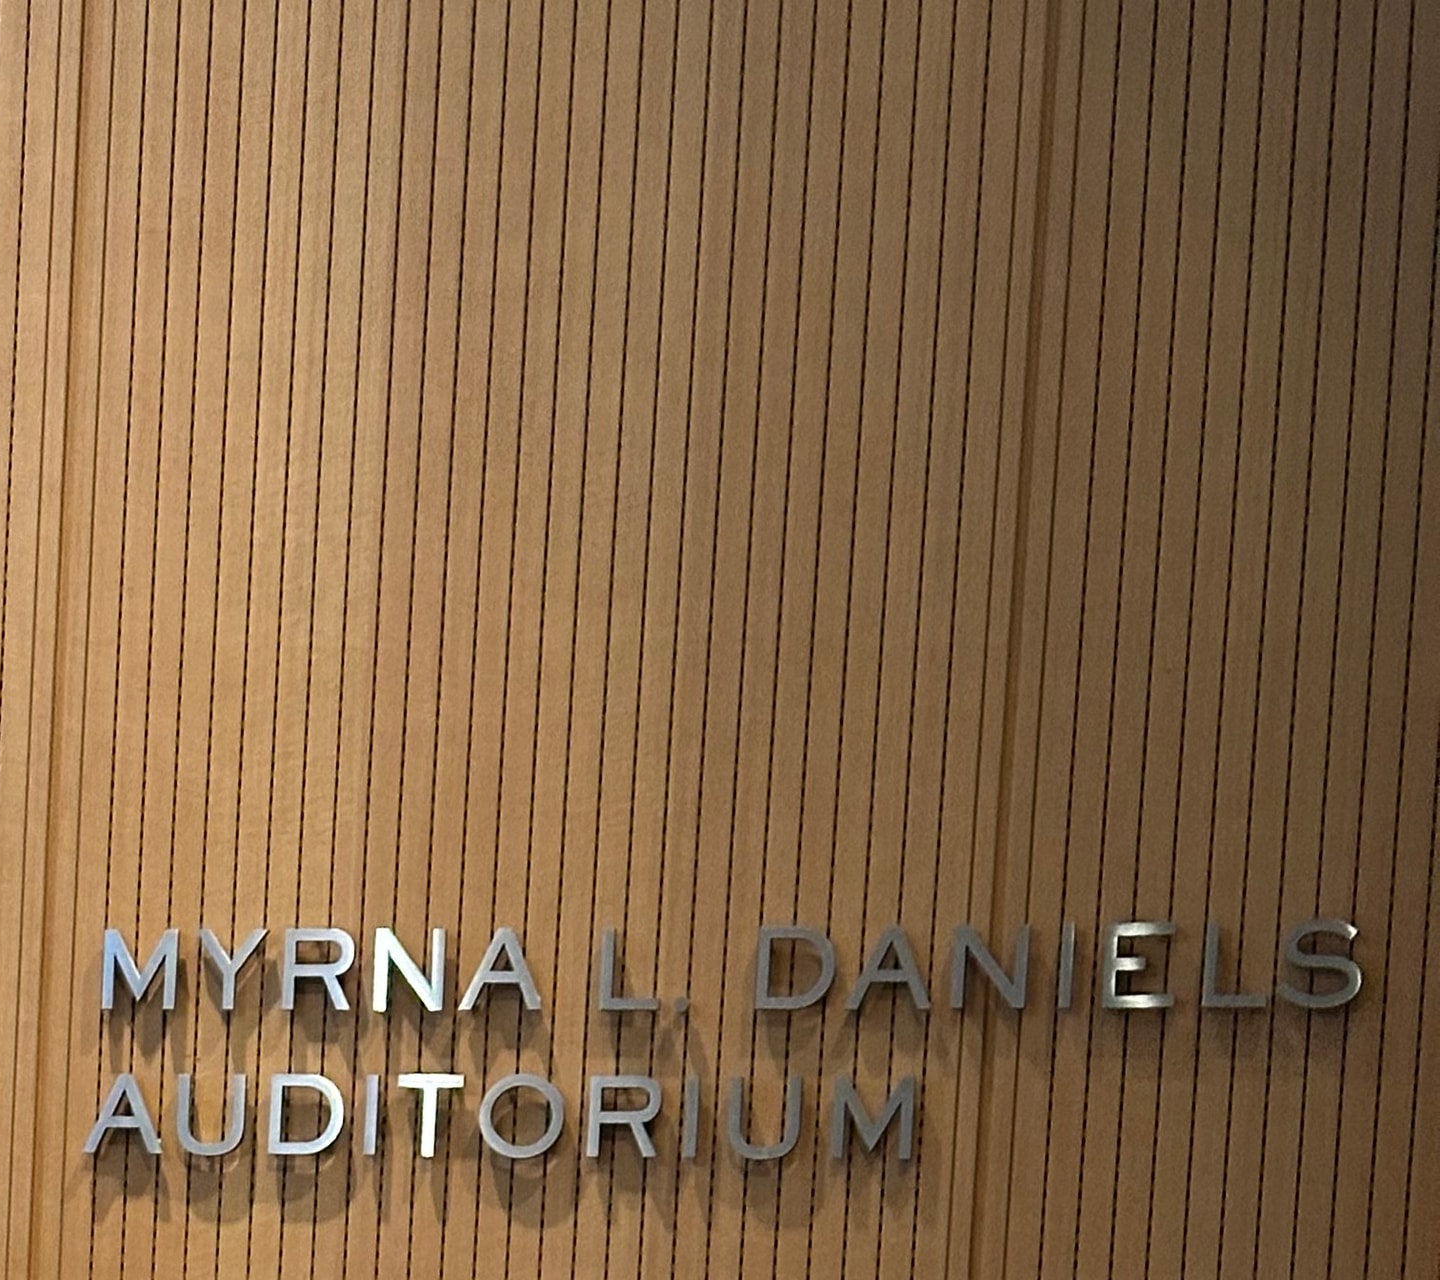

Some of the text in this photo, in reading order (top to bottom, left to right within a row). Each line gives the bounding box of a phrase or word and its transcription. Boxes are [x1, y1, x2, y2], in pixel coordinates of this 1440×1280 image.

[101, 918, 1362, 1014] MYRNA L. DANIELS
[82, 1072, 917, 1160] AUDITORIUM
